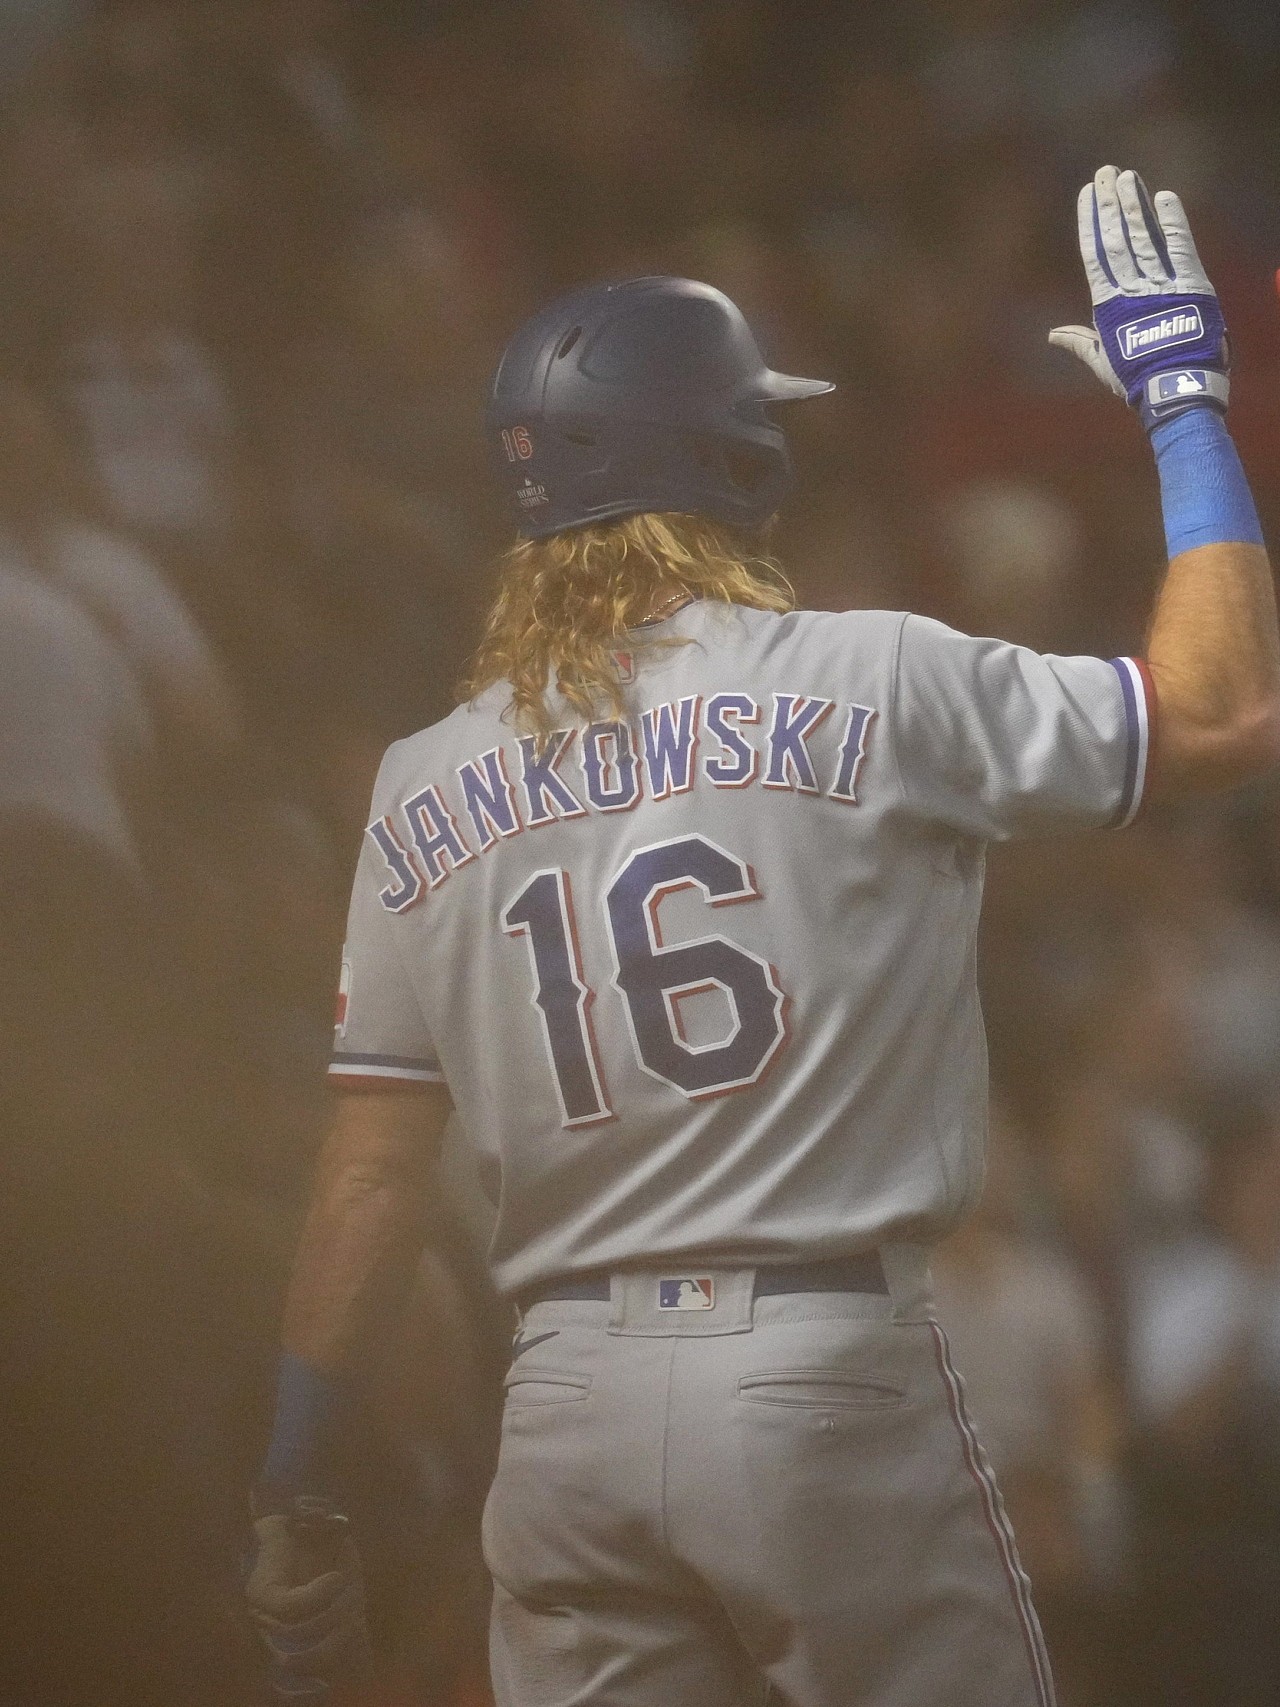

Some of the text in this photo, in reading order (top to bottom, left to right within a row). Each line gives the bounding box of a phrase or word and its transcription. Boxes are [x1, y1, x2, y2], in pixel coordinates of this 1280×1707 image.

[502, 426, 532, 462] 16
[364, 692, 879, 914] JANKOWSKI
[500, 832, 791, 1130] 16
